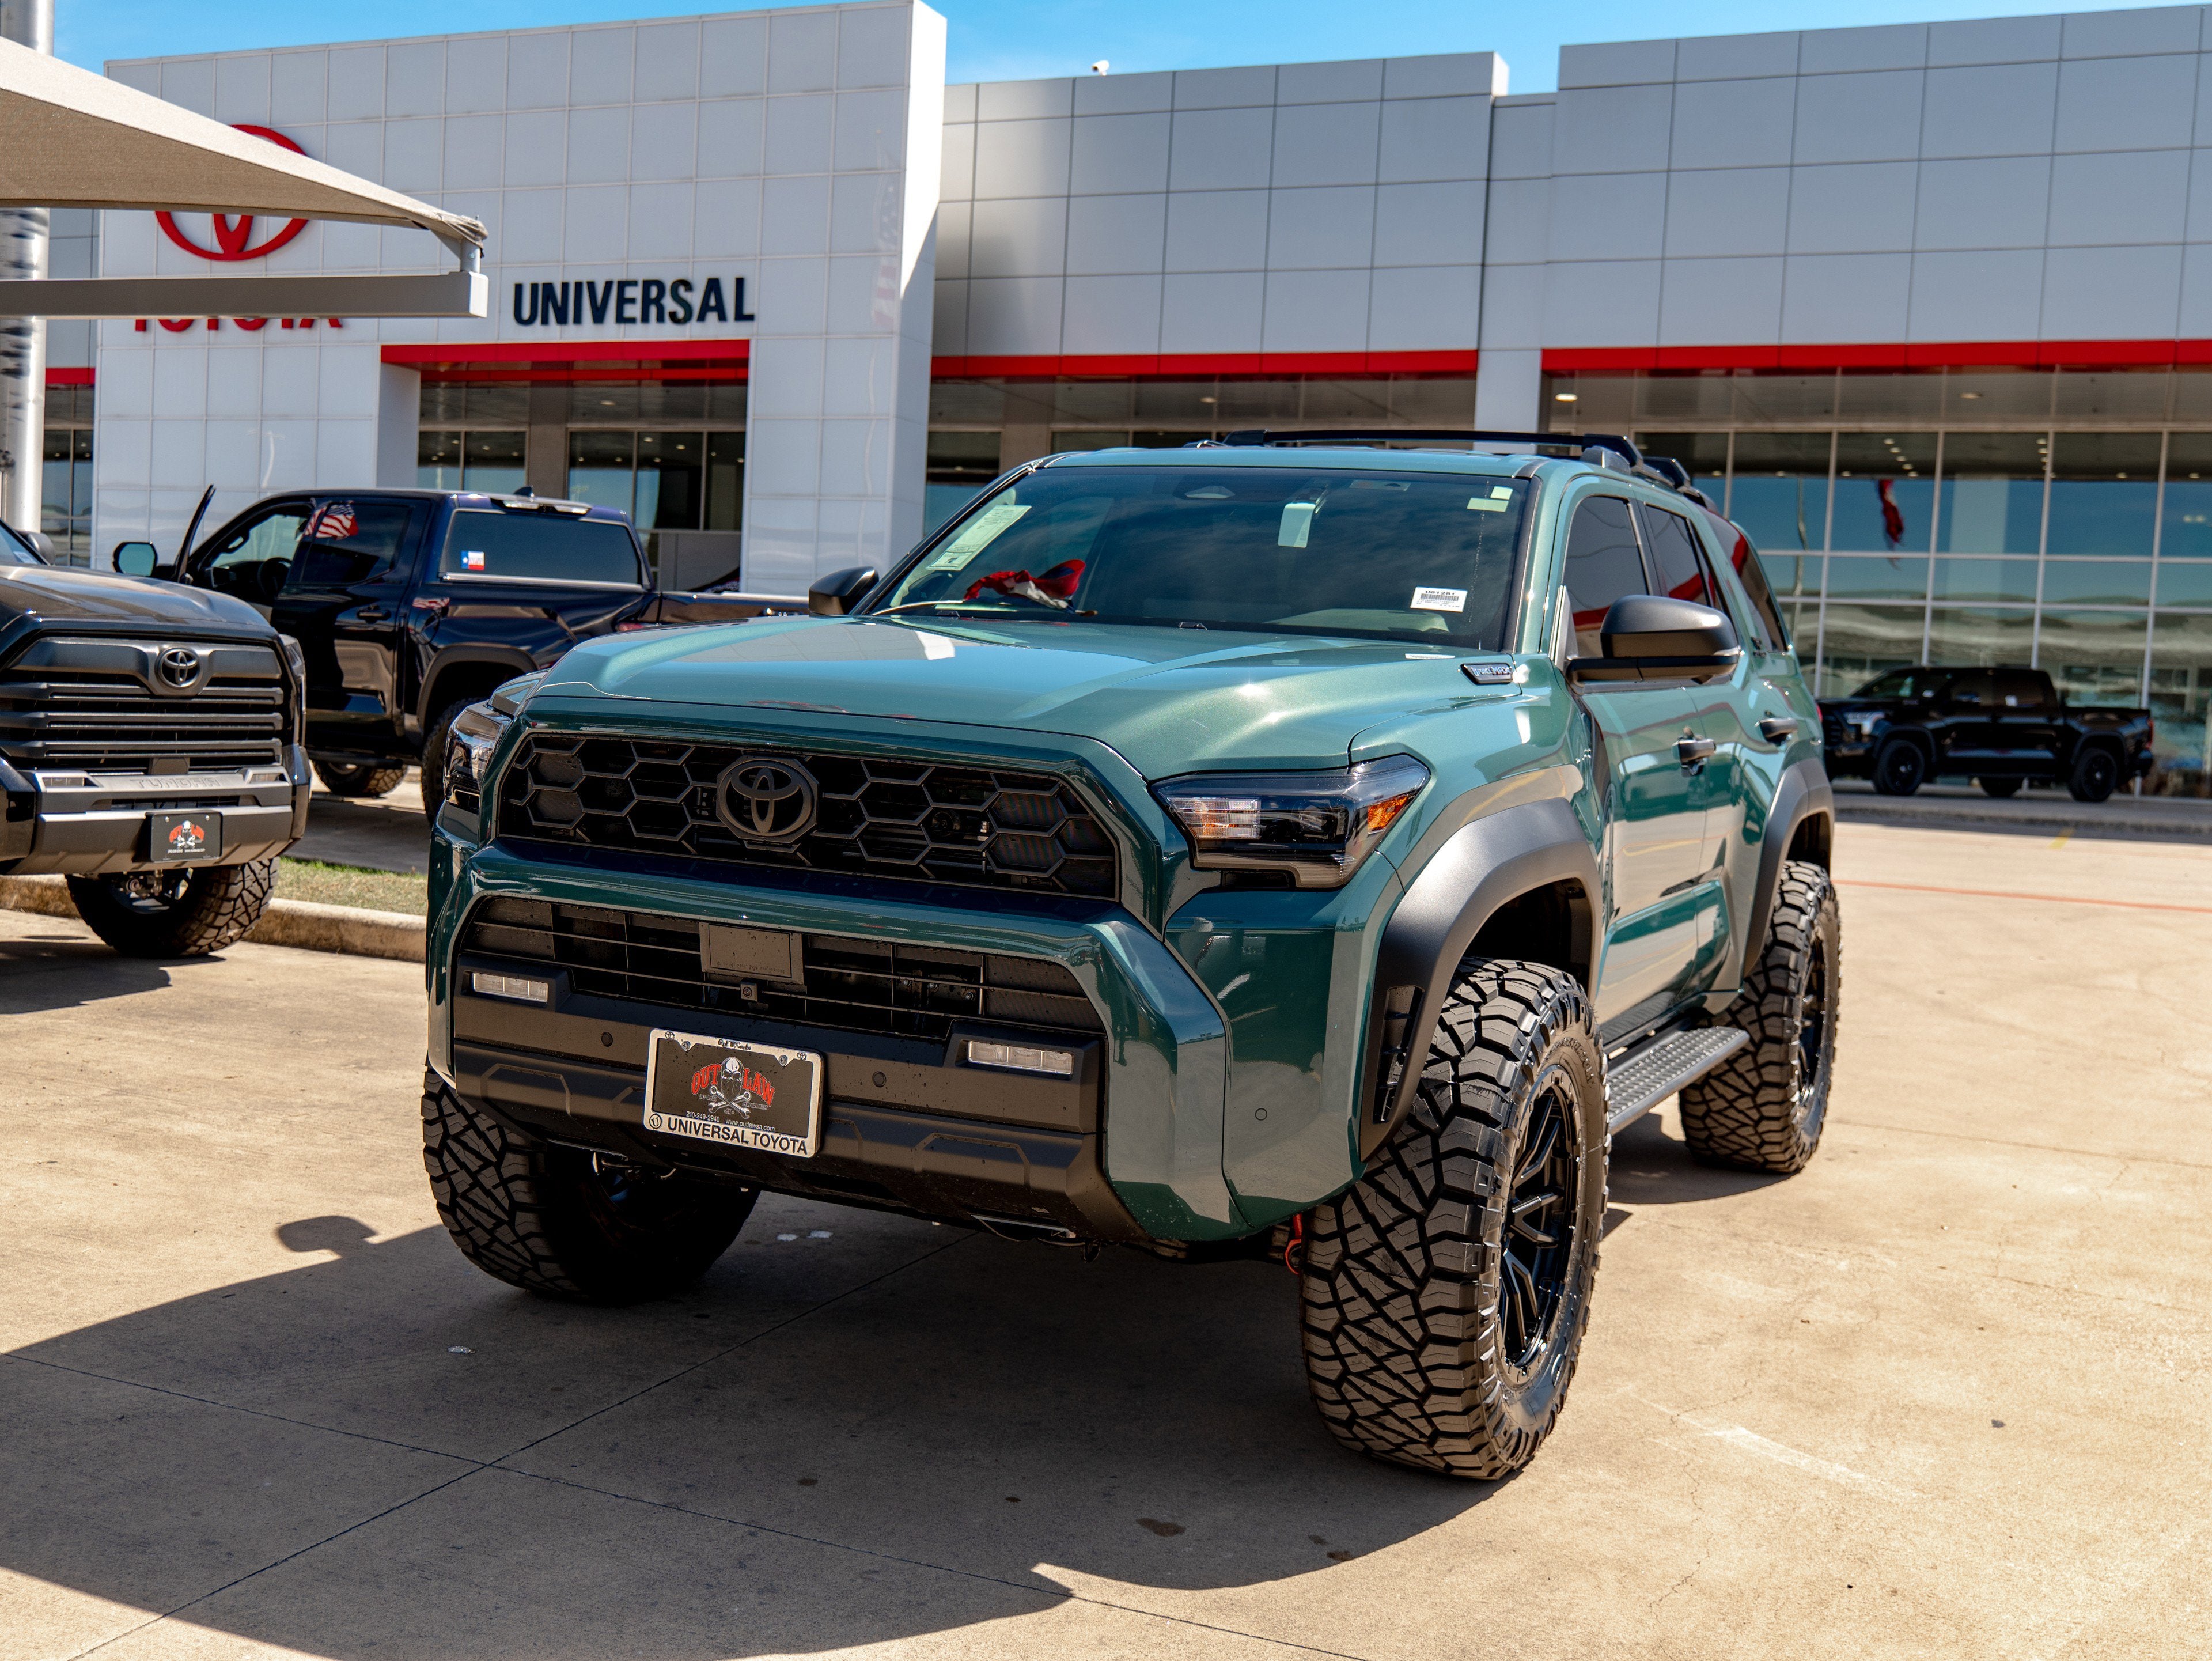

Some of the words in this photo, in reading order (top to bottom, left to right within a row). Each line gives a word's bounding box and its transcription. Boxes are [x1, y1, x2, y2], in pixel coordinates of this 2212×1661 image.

[513, 277, 755, 326] UNIVERSAL
[130, 778, 221, 789] TUNDRA
[668, 1117, 749, 1145] UNIVERSAL
[752, 1131, 808, 1155] TOYOTA
[686, 1110, 720, 1122] 210-249-2940
[725, 1118, 775, 1132] www.outlawsa.com
